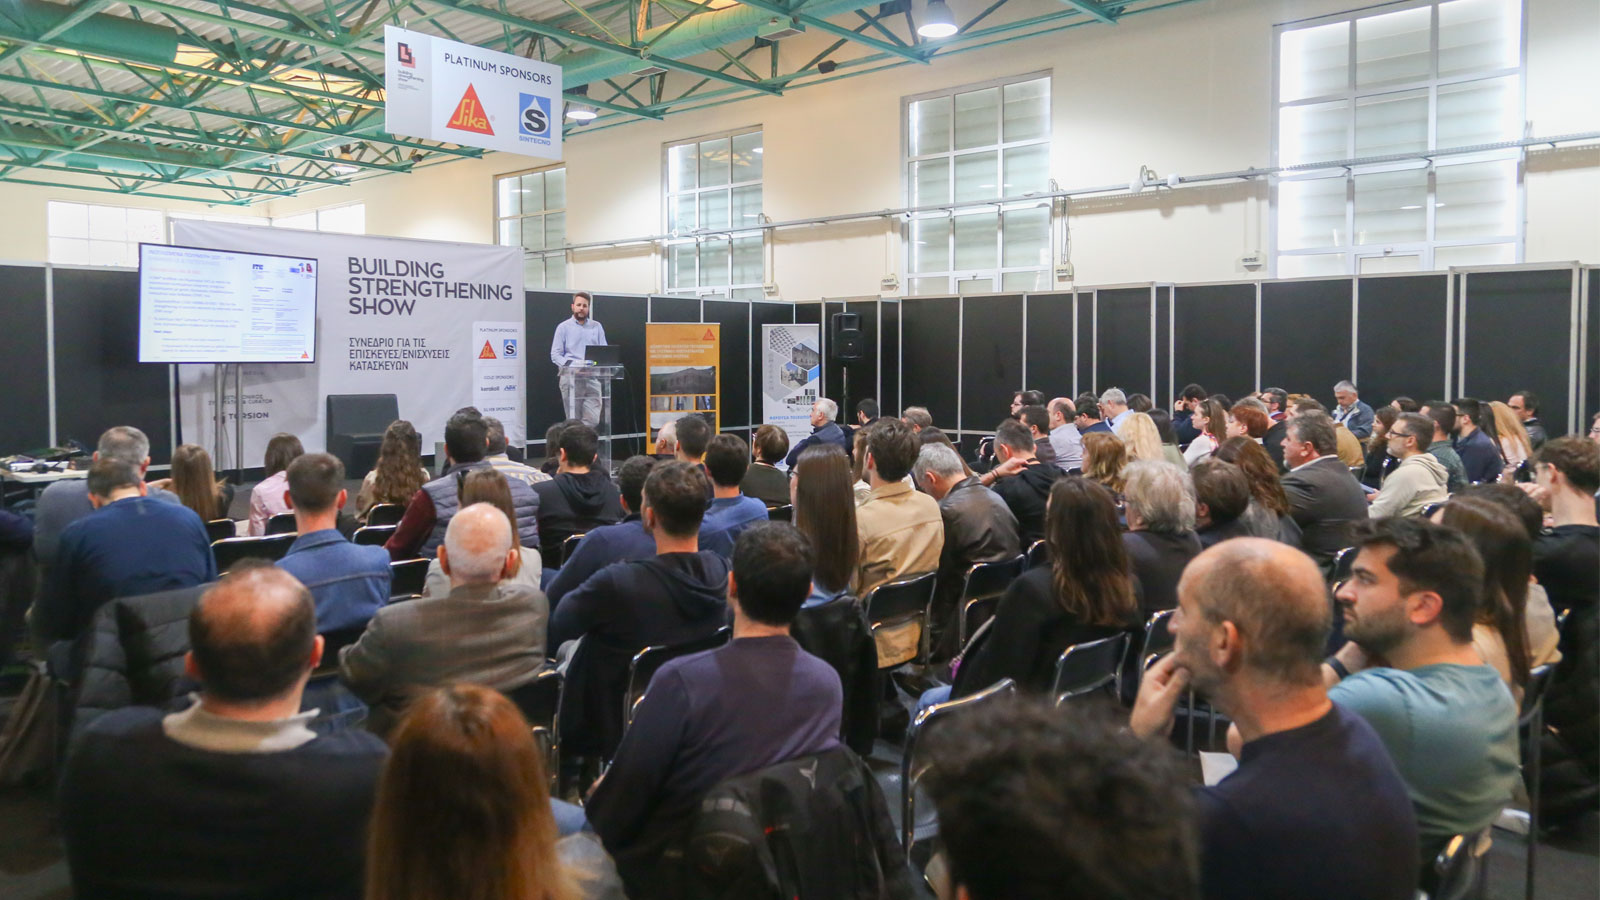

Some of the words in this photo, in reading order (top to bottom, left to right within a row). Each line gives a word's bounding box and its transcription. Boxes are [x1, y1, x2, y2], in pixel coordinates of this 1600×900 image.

[445, 52, 497, 73] PLATINUM
[500, 65, 552, 86] SPONSORS
[452, 98, 488, 130] Sika
[519, 135, 551, 145] SINTECNO
[348, 256, 444, 279] BUILDING
[348, 276, 513, 301] STRENGTHENING
[348, 297, 416, 316] SHOW
[349, 337, 394, 348] ΣΥΝΕΔΡΙΟ
[397, 338, 410, 348] ΓΙΑ
[413, 338, 427, 348] ΤΙΣ
[349, 349, 451, 360] ΕΠΙΣΚΕΥΕΣ/ΕΝΙΣΧΥΣΕΙΣ
[349, 361, 409, 371] ΚΑΤΑΣΚΕΥΩΝ
